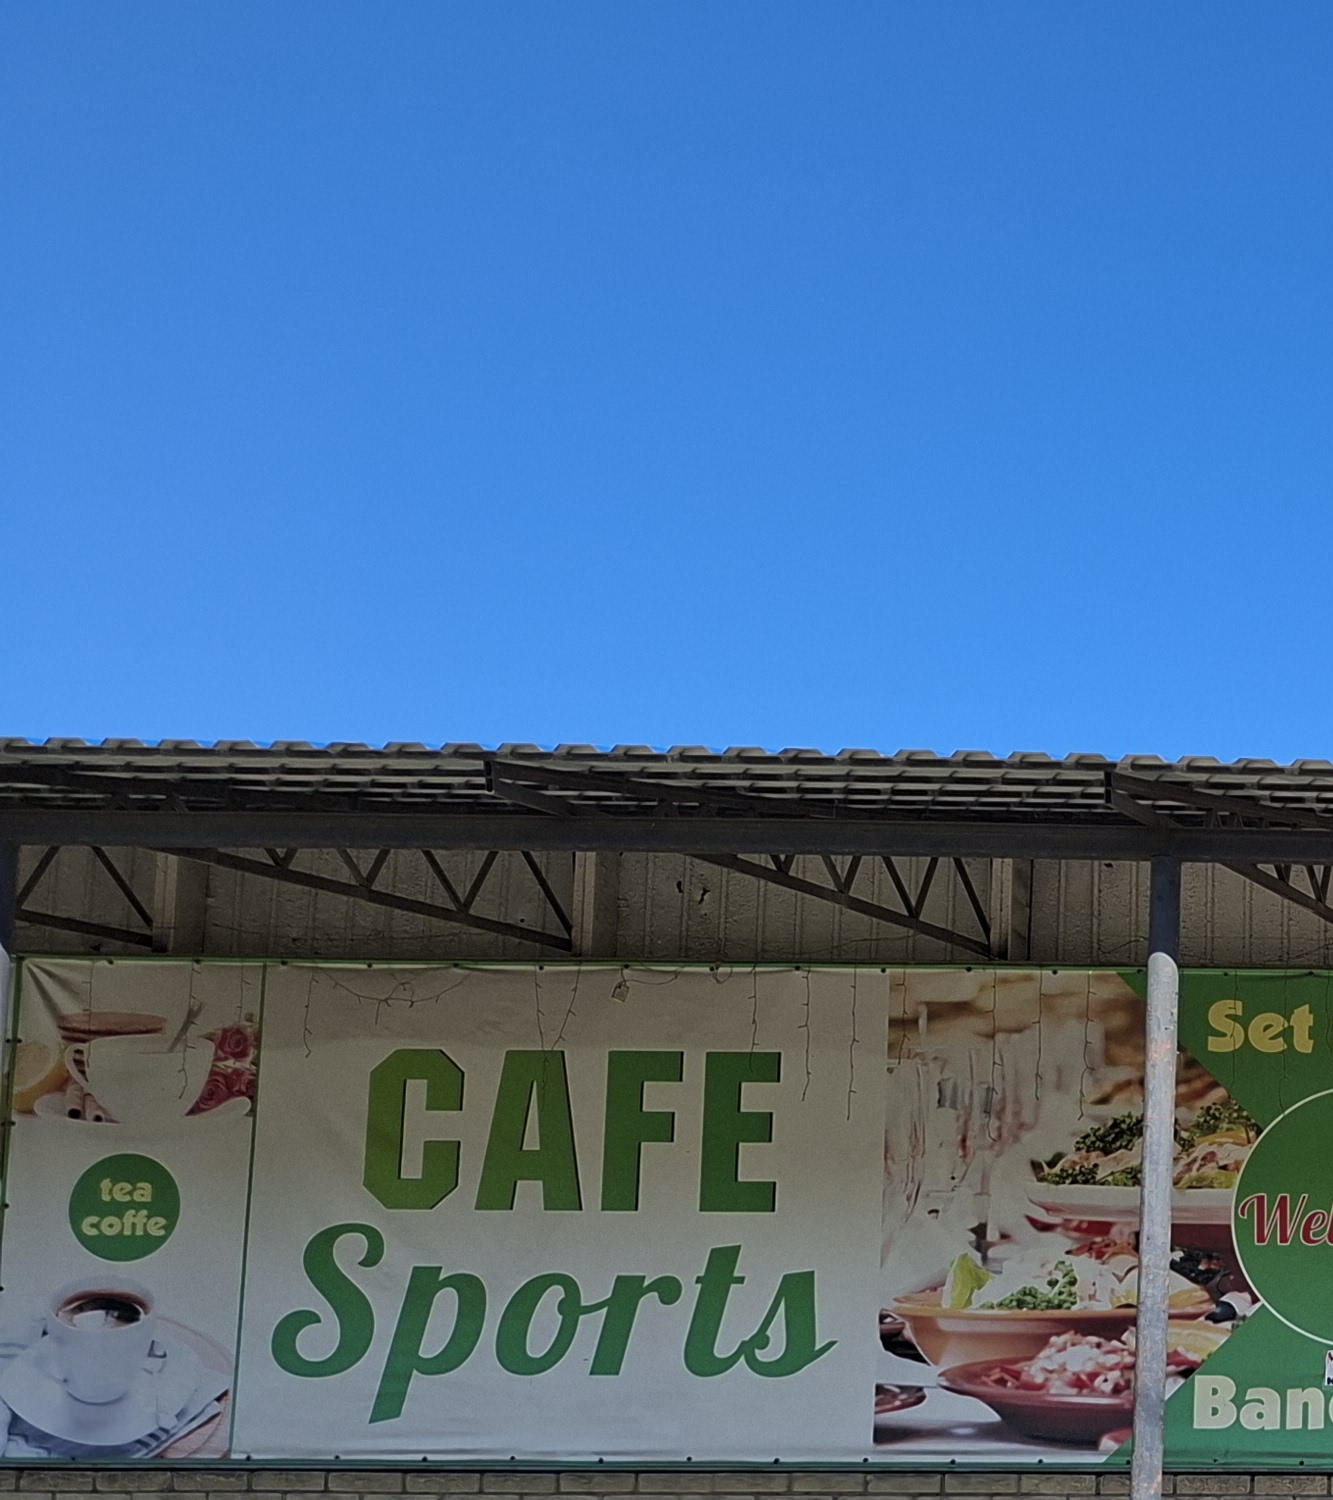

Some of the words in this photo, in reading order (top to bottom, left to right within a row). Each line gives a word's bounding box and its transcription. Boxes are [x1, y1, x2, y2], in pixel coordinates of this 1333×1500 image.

[1206, 1000, 1314, 1055] Set
[362, 1048, 782, 1212] CAFE
[100, 1178, 153, 1202] tea
[82, 1209, 167, 1236] coffe
[271, 1223, 839, 1425] Sports
